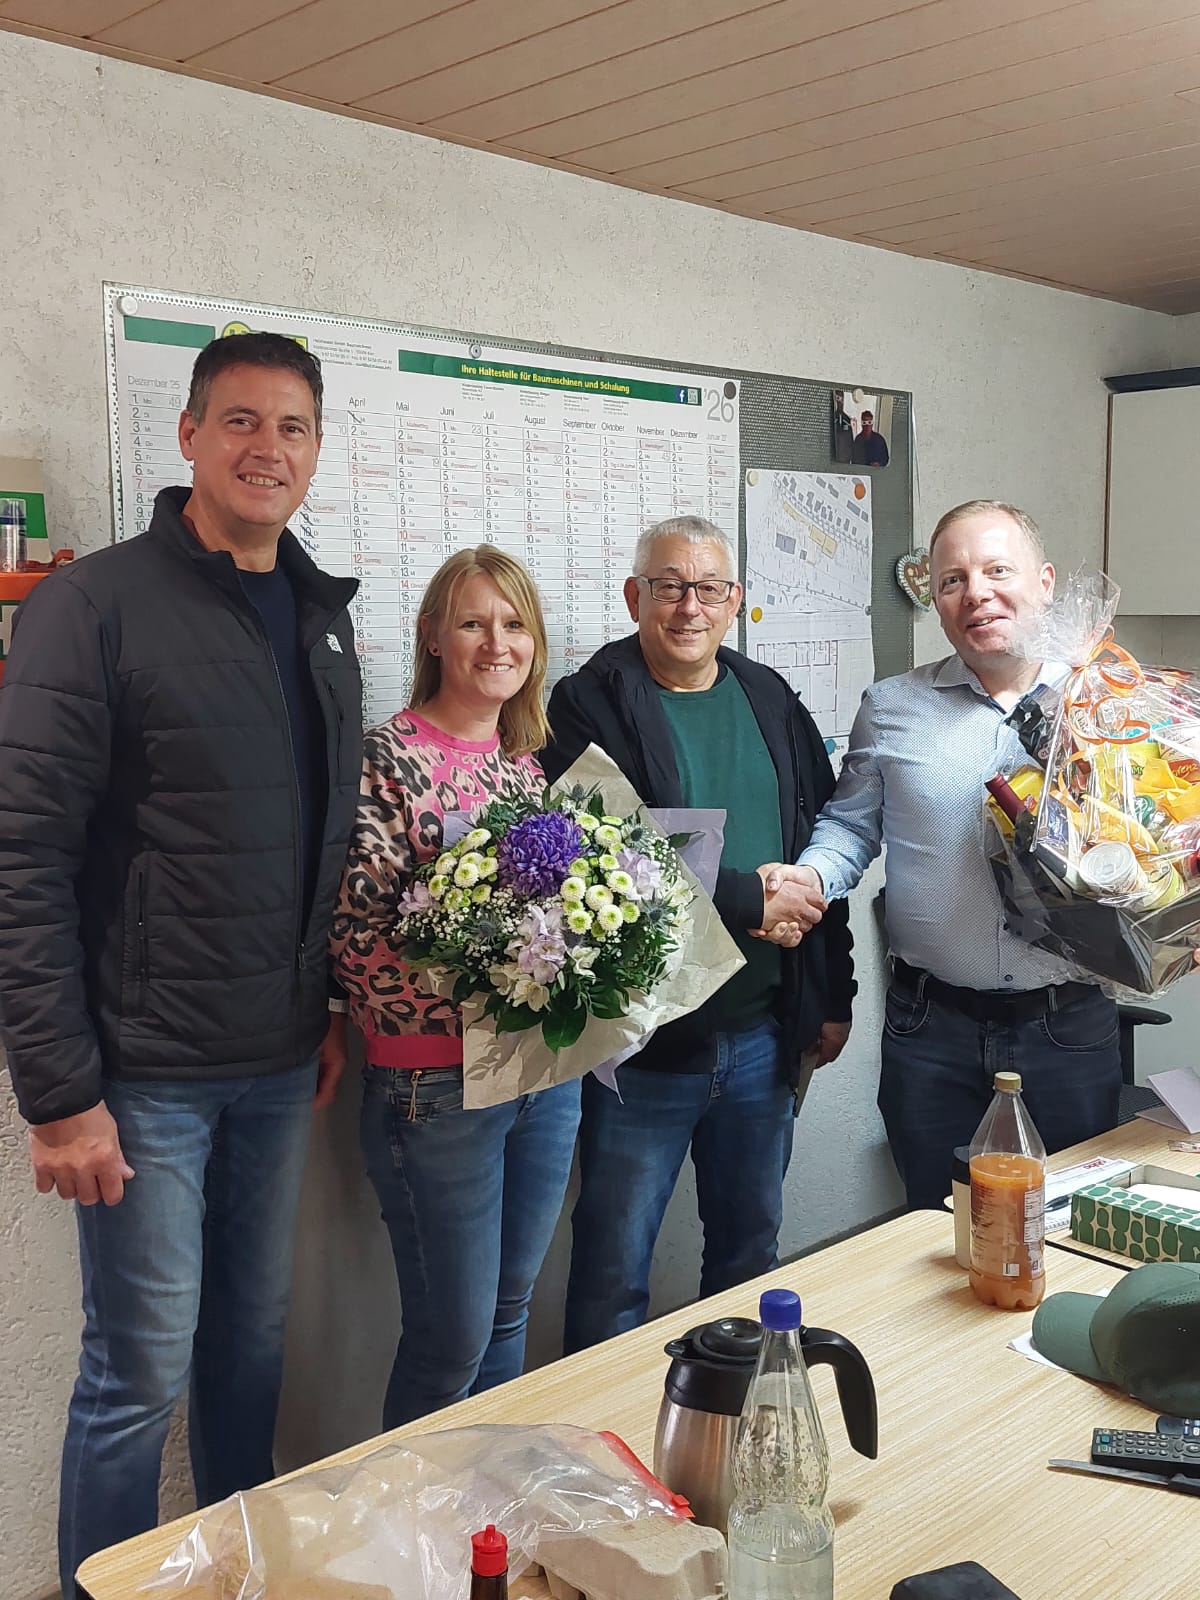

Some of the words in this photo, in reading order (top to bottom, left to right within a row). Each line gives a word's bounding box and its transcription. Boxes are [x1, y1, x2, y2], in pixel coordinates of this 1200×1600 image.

[128, 376, 168, 388] Dezember
[462, 364, 476, 375] Ihre
[478, 366, 518, 380] Haltestelle
[520, 371, 531, 380] für
[533, 374, 582, 388] Baumaschinen
[585, 380, 598, 388] und
[600, 382, 630, 394] Schalung
[349, 396, 366, 408] April
[396, 402, 410, 412] Mai
[440, 408, 454, 416] Juni
[483, 411, 494, 420] Juli
[524, 416, 546, 426] August
[563, 419, 596, 430] September
[601, 422, 624, 432] Oktober
[637, 426, 664, 436] November
[671, 430, 698, 438] Dezember
